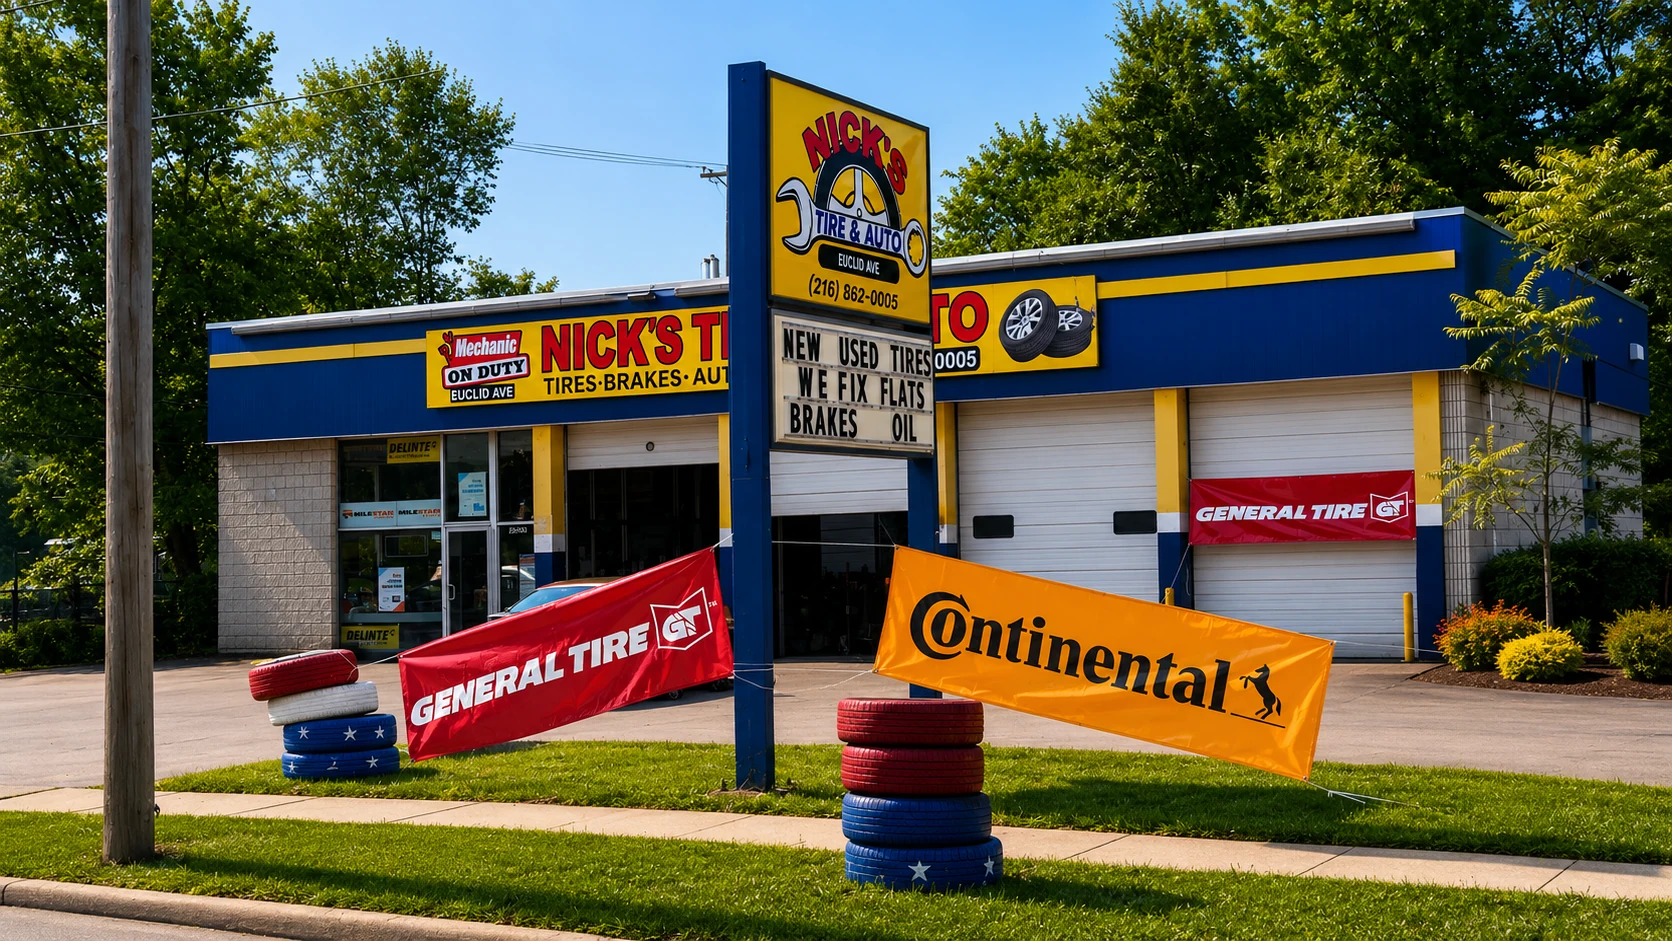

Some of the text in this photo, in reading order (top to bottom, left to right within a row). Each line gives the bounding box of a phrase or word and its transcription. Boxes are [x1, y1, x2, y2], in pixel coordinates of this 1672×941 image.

[802, 111, 907, 195] NICK'S
[815, 209, 901, 252] TIRE & AUTO
[838, 253, 880, 275] EUCLID AVE
[809, 273, 899, 310] (216) 862-0005
[454, 335, 517, 358] Mechanic
[541, 314, 684, 373] NICK'S
[783, 328, 931, 377] NEW USED TIRES
[448, 358, 526, 384] ON DUTY
[798, 367, 925, 410] WE FIX FLATS
[451, 385, 513, 401] EUCLID AVE
[790, 403, 917, 443] BRAKES OIL
[389, 441, 431, 454] DELINTE
[1195, 500, 1404, 522] GENERAL TIRE GT
[346, 630, 390, 641] DELINTE
[909, 591, 1231, 714] Continental
[410, 605, 702, 727] GENERAL TIRE GT
